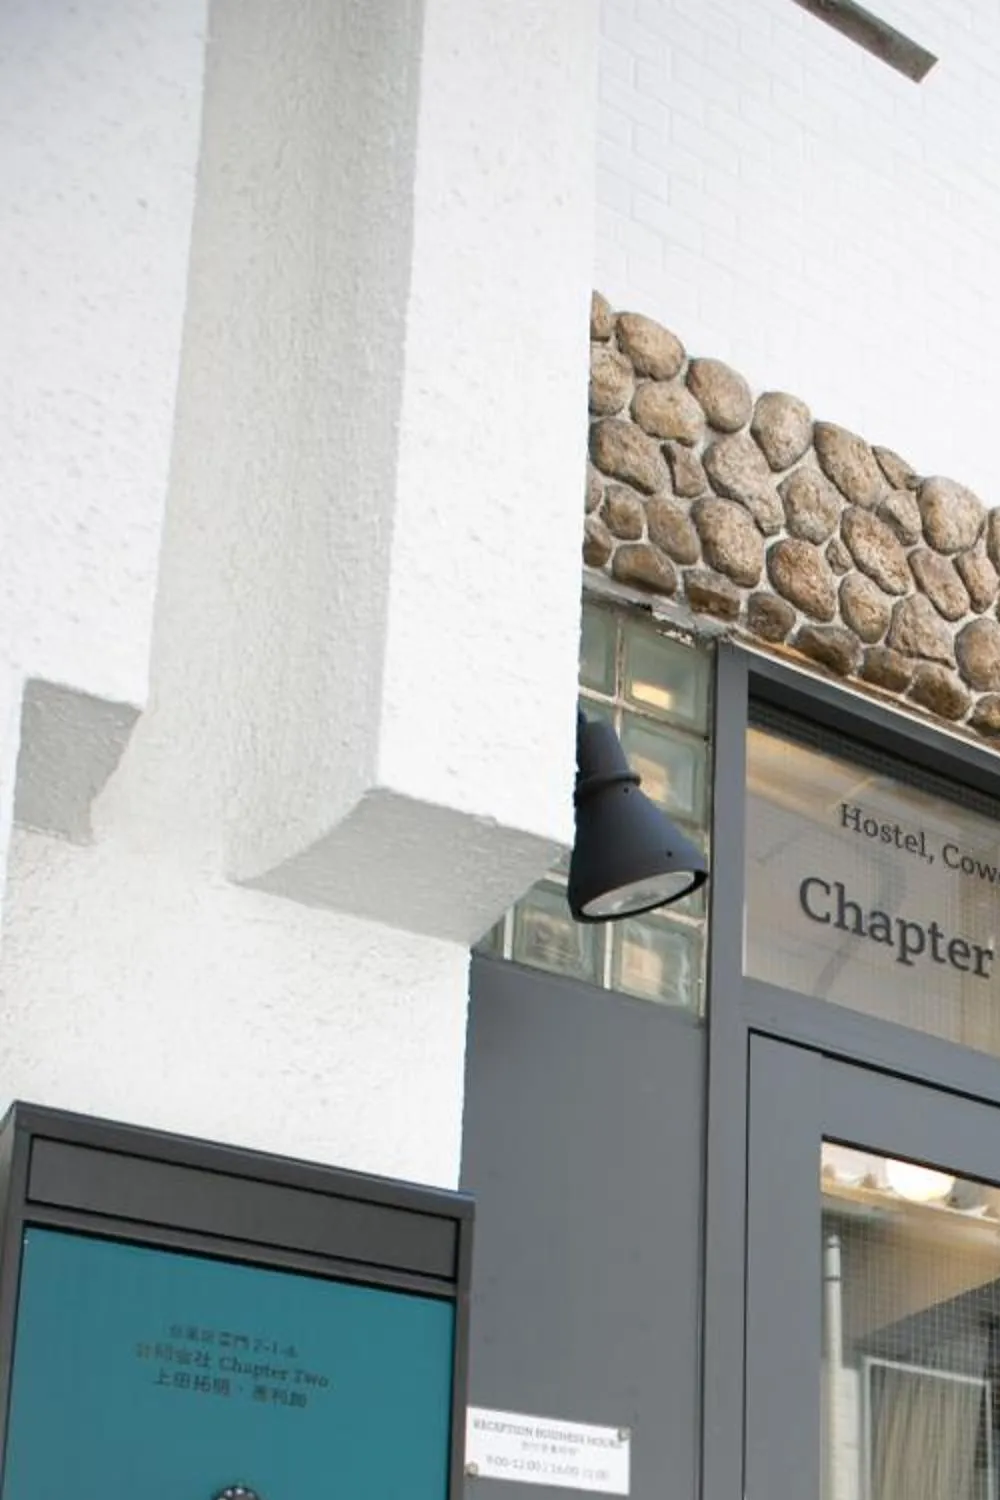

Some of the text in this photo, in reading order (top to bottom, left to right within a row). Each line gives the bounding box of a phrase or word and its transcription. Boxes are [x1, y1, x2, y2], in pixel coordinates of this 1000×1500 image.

[840, 803, 934, 864] Hostel,
[799, 876, 995, 980] Chapter
[294, 1369, 329, 1388] Two
